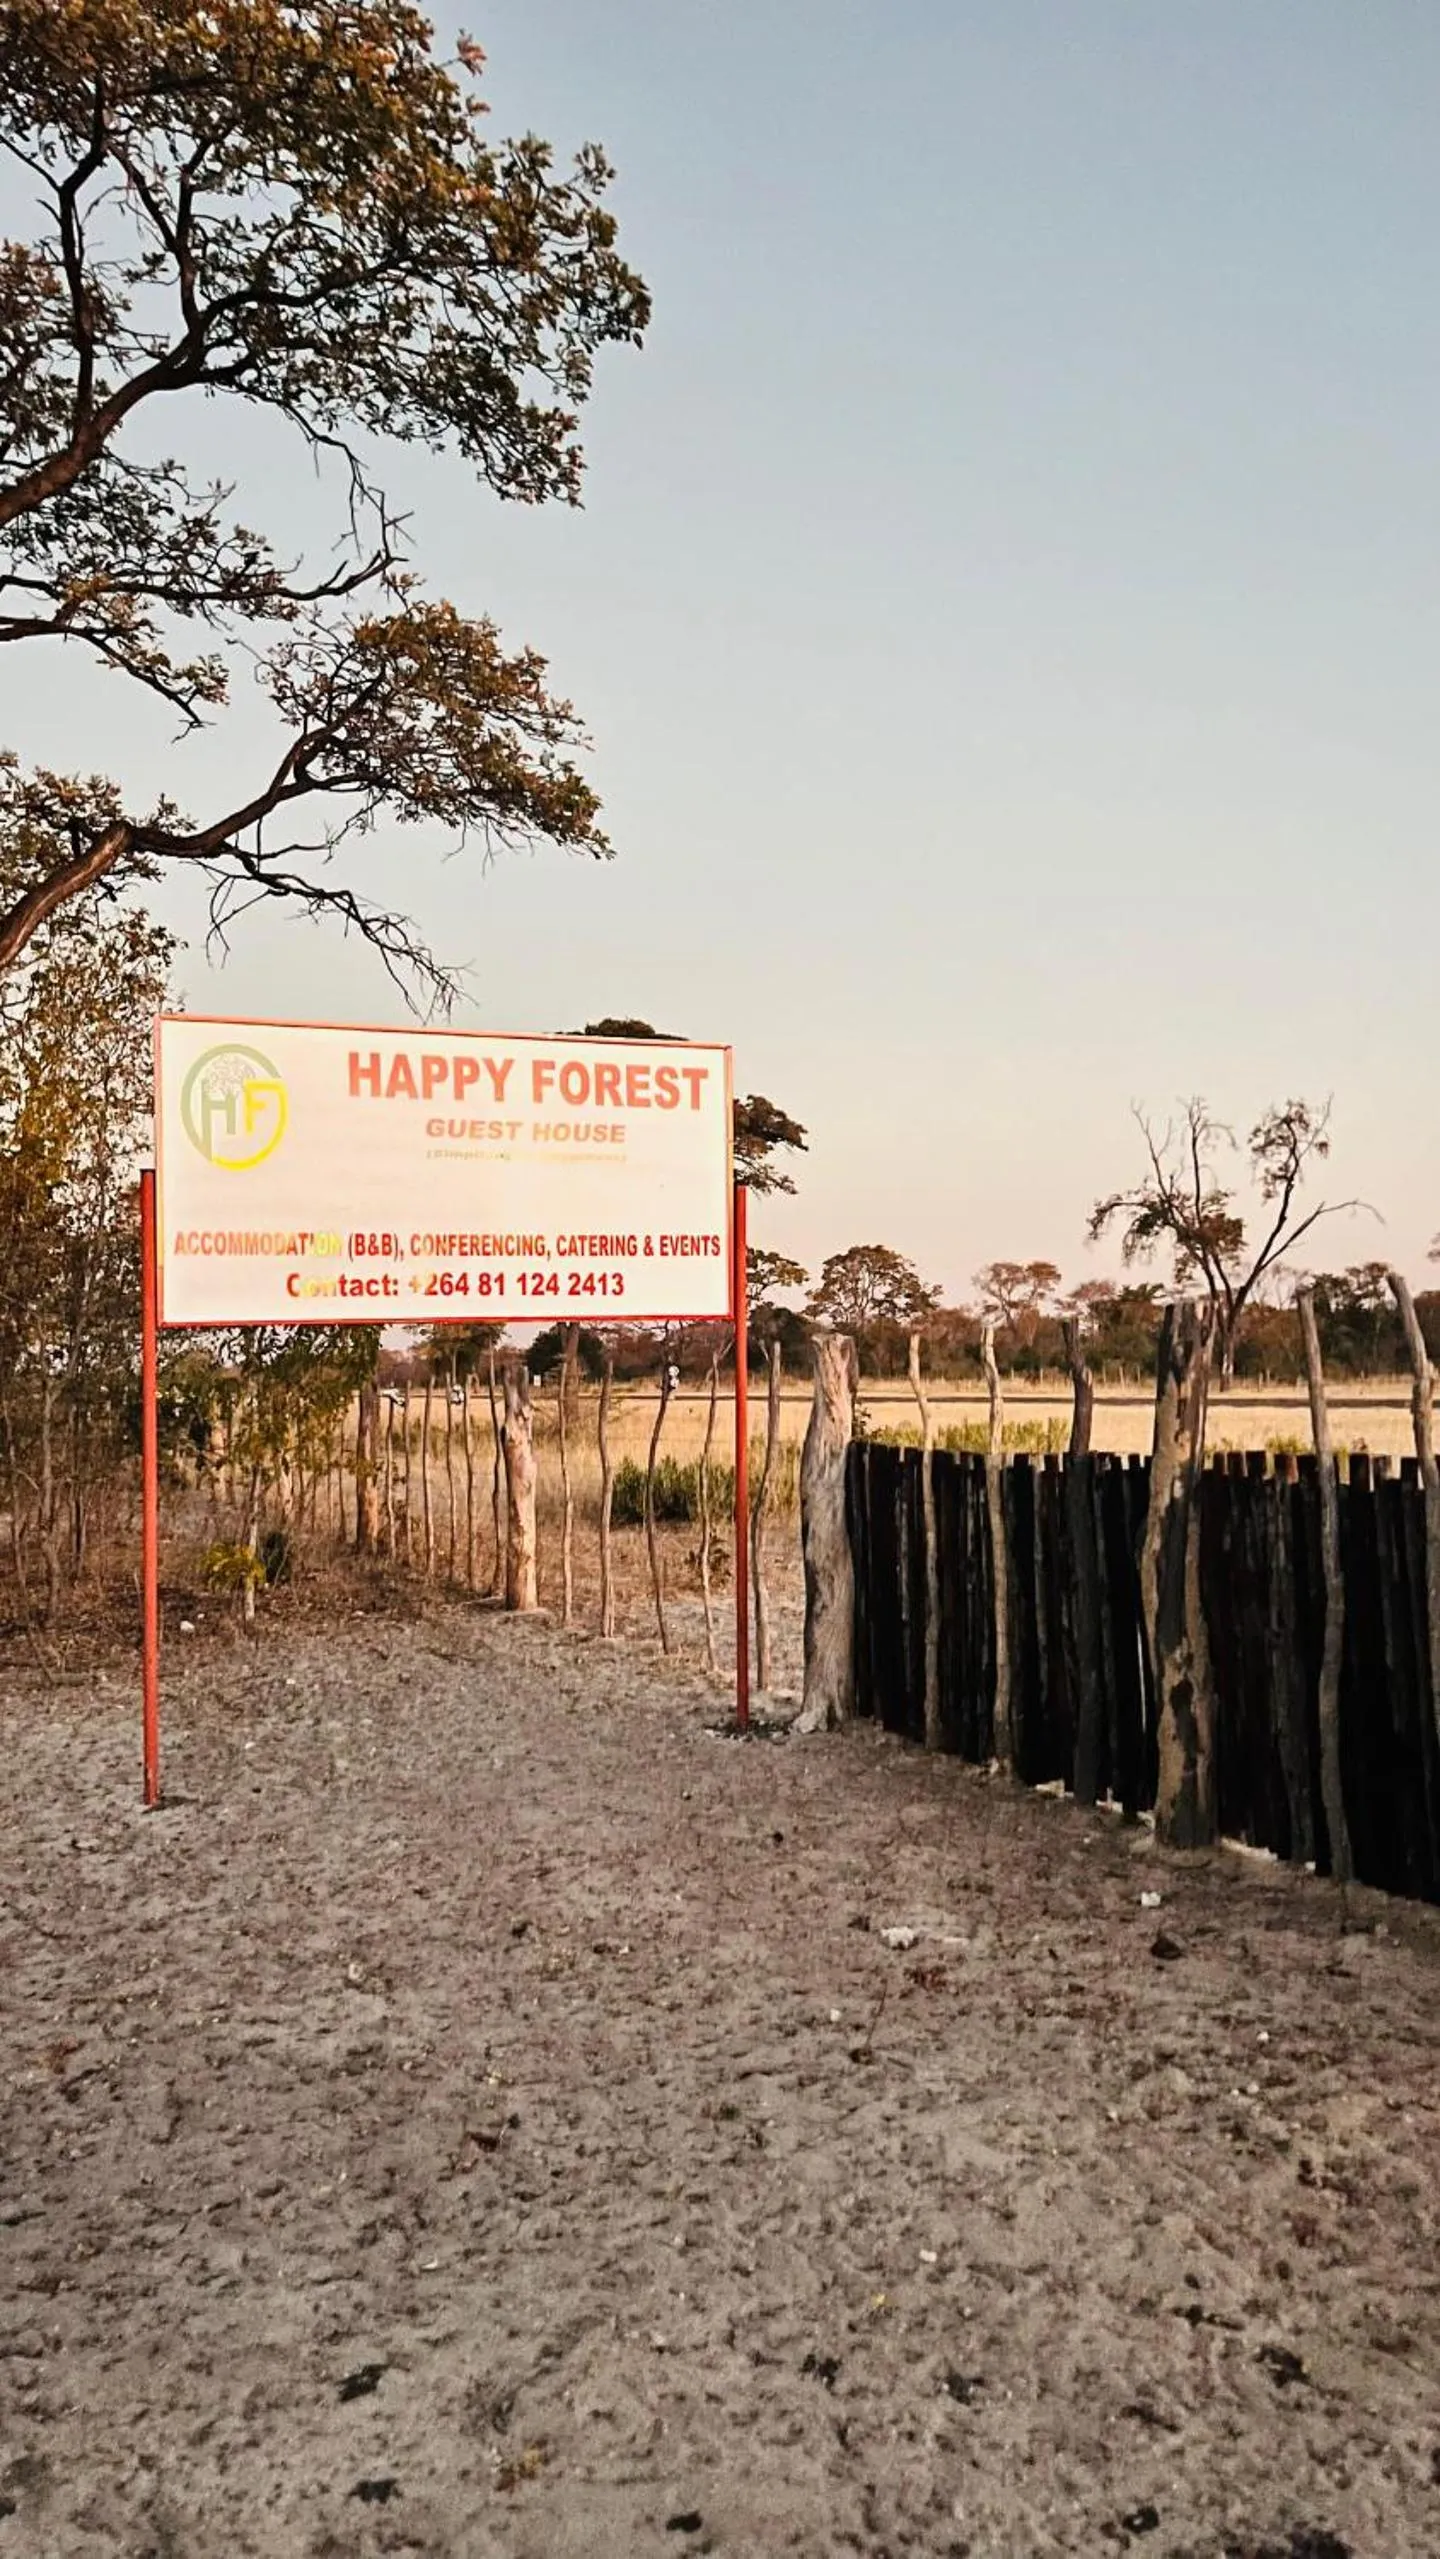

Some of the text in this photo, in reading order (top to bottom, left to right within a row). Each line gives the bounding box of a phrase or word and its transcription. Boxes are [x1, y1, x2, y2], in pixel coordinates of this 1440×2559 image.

[348, 1051, 709, 1111] HAPPY FOREST
[425, 1117, 627, 1144] GUEST HOUSE
[347, 1232, 405, 1262] (B&B),
[410, 1234, 551, 1261] CONFERENCING,
[556, 1234, 637, 1257] CATERING
[643, 1235, 655, 1257] &
[659, 1235, 721, 1257] EVENTS
[478, 1272, 505, 1297] 81
[516, 1272, 560, 1297] 124
[567, 1272, 625, 1297] 2413
